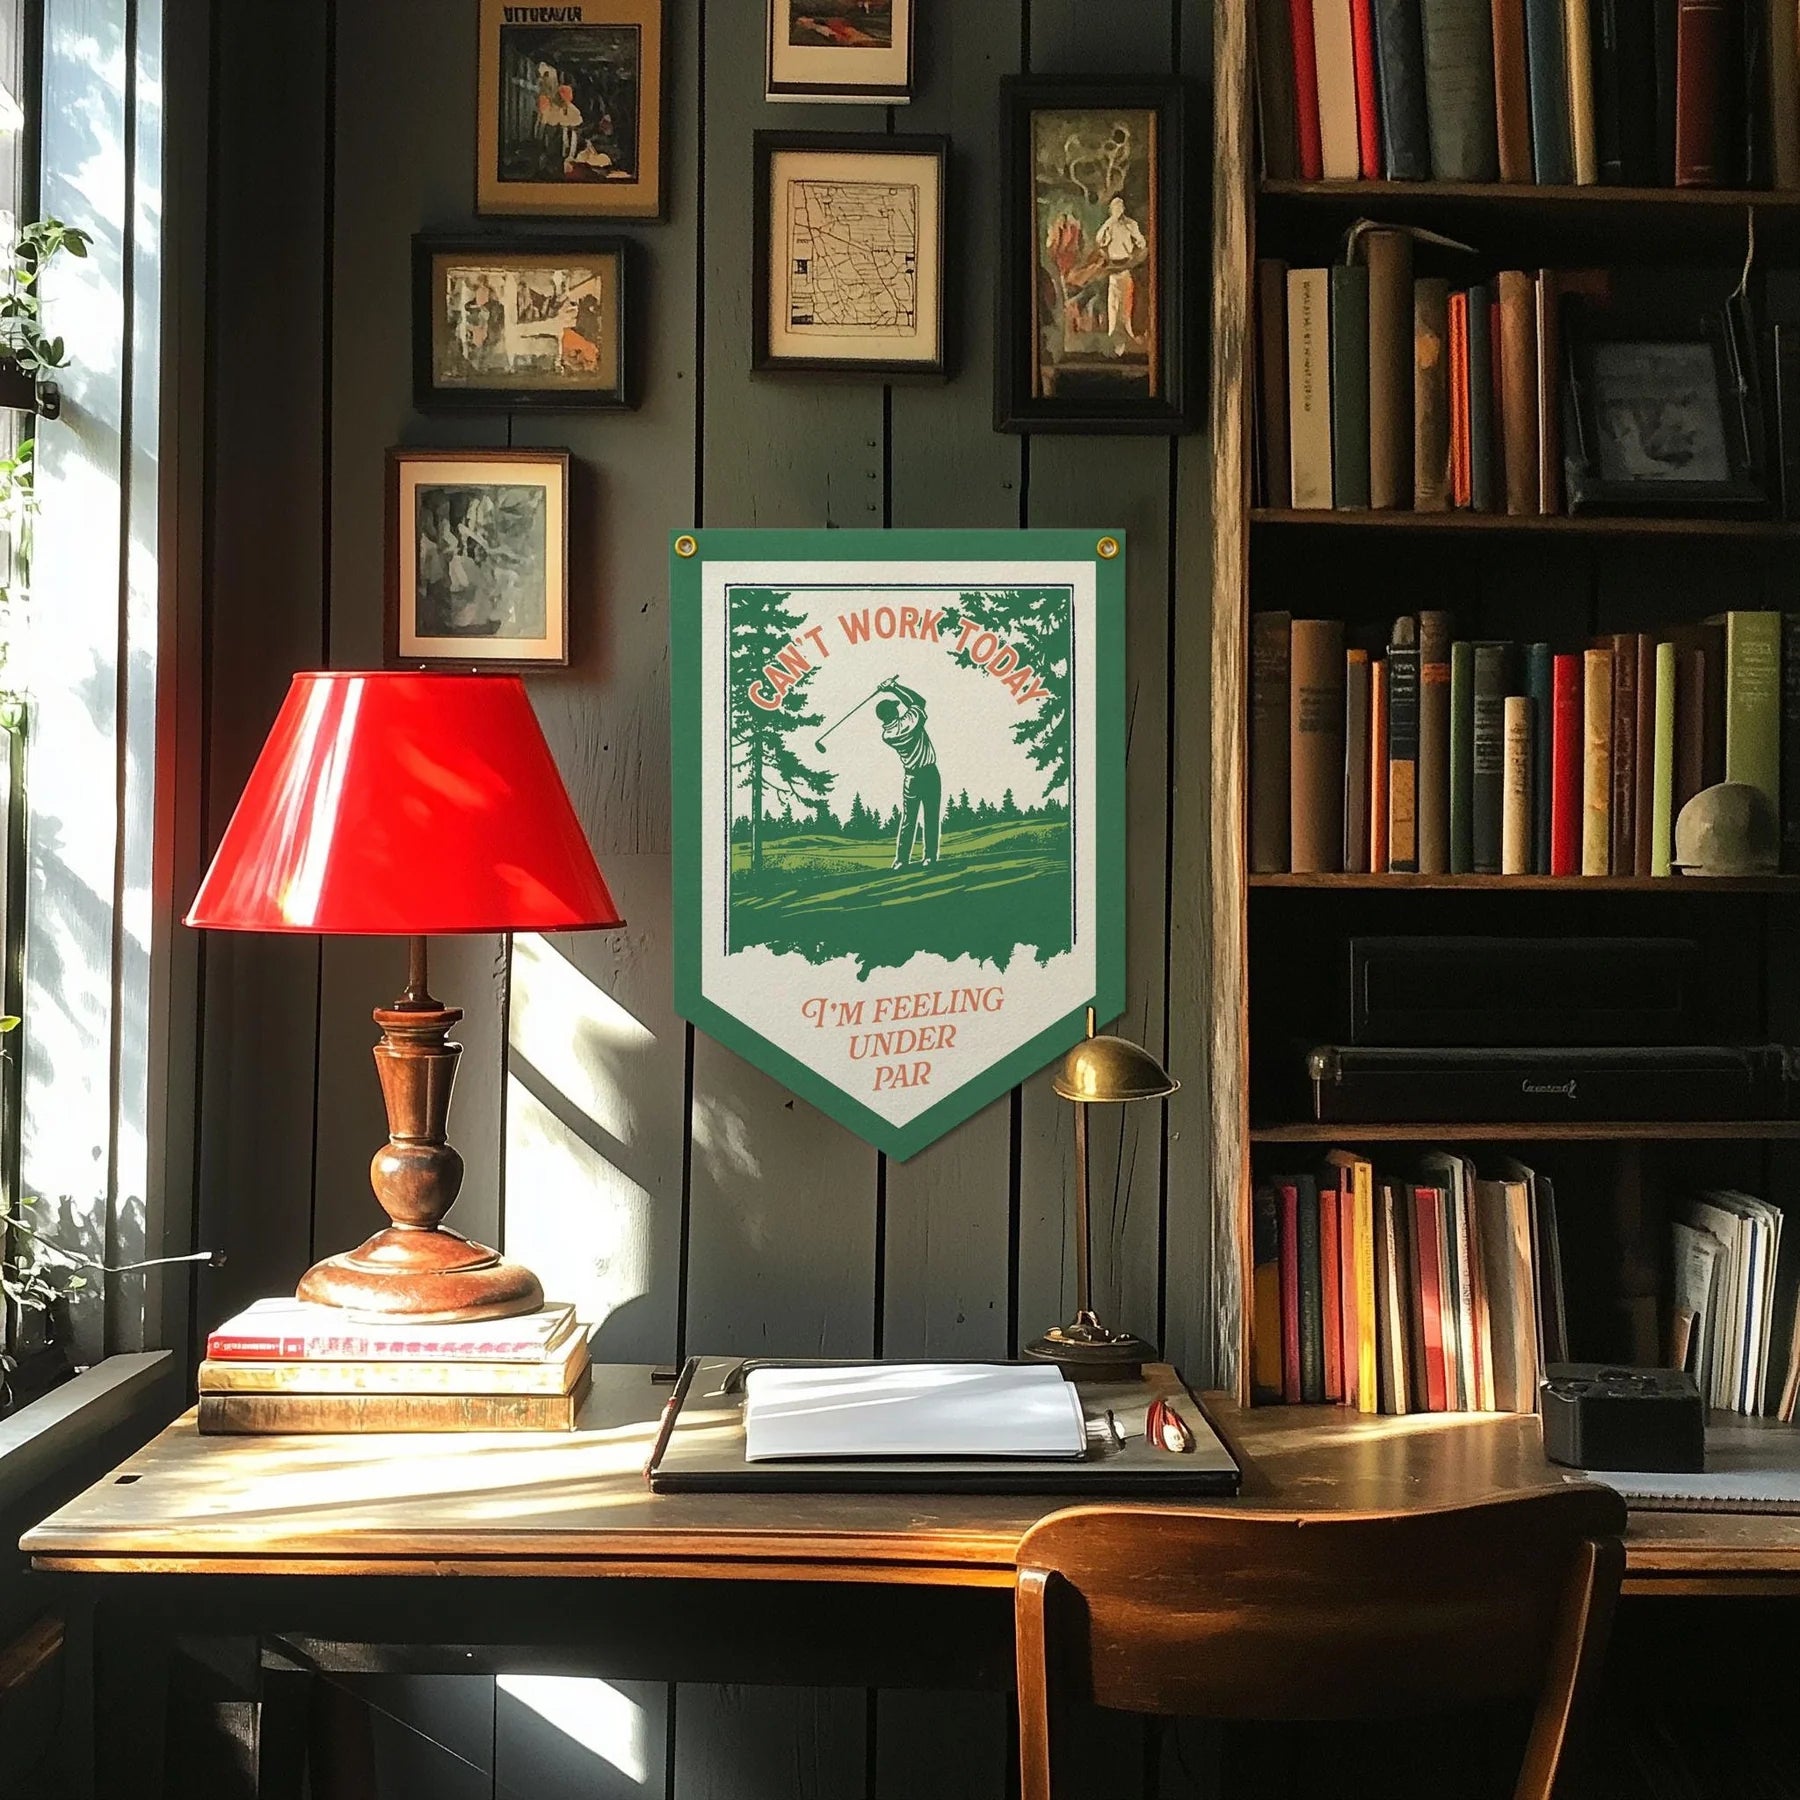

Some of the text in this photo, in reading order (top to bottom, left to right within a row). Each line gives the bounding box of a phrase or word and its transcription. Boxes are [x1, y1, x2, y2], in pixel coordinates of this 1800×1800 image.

[749, 606, 1049, 710] CAN'T WORK TODAY
[801, 986, 1006, 1029] I'M FEELING
[849, 1024, 957, 1060] UNDER
[872, 1060, 932, 1092] PAR
